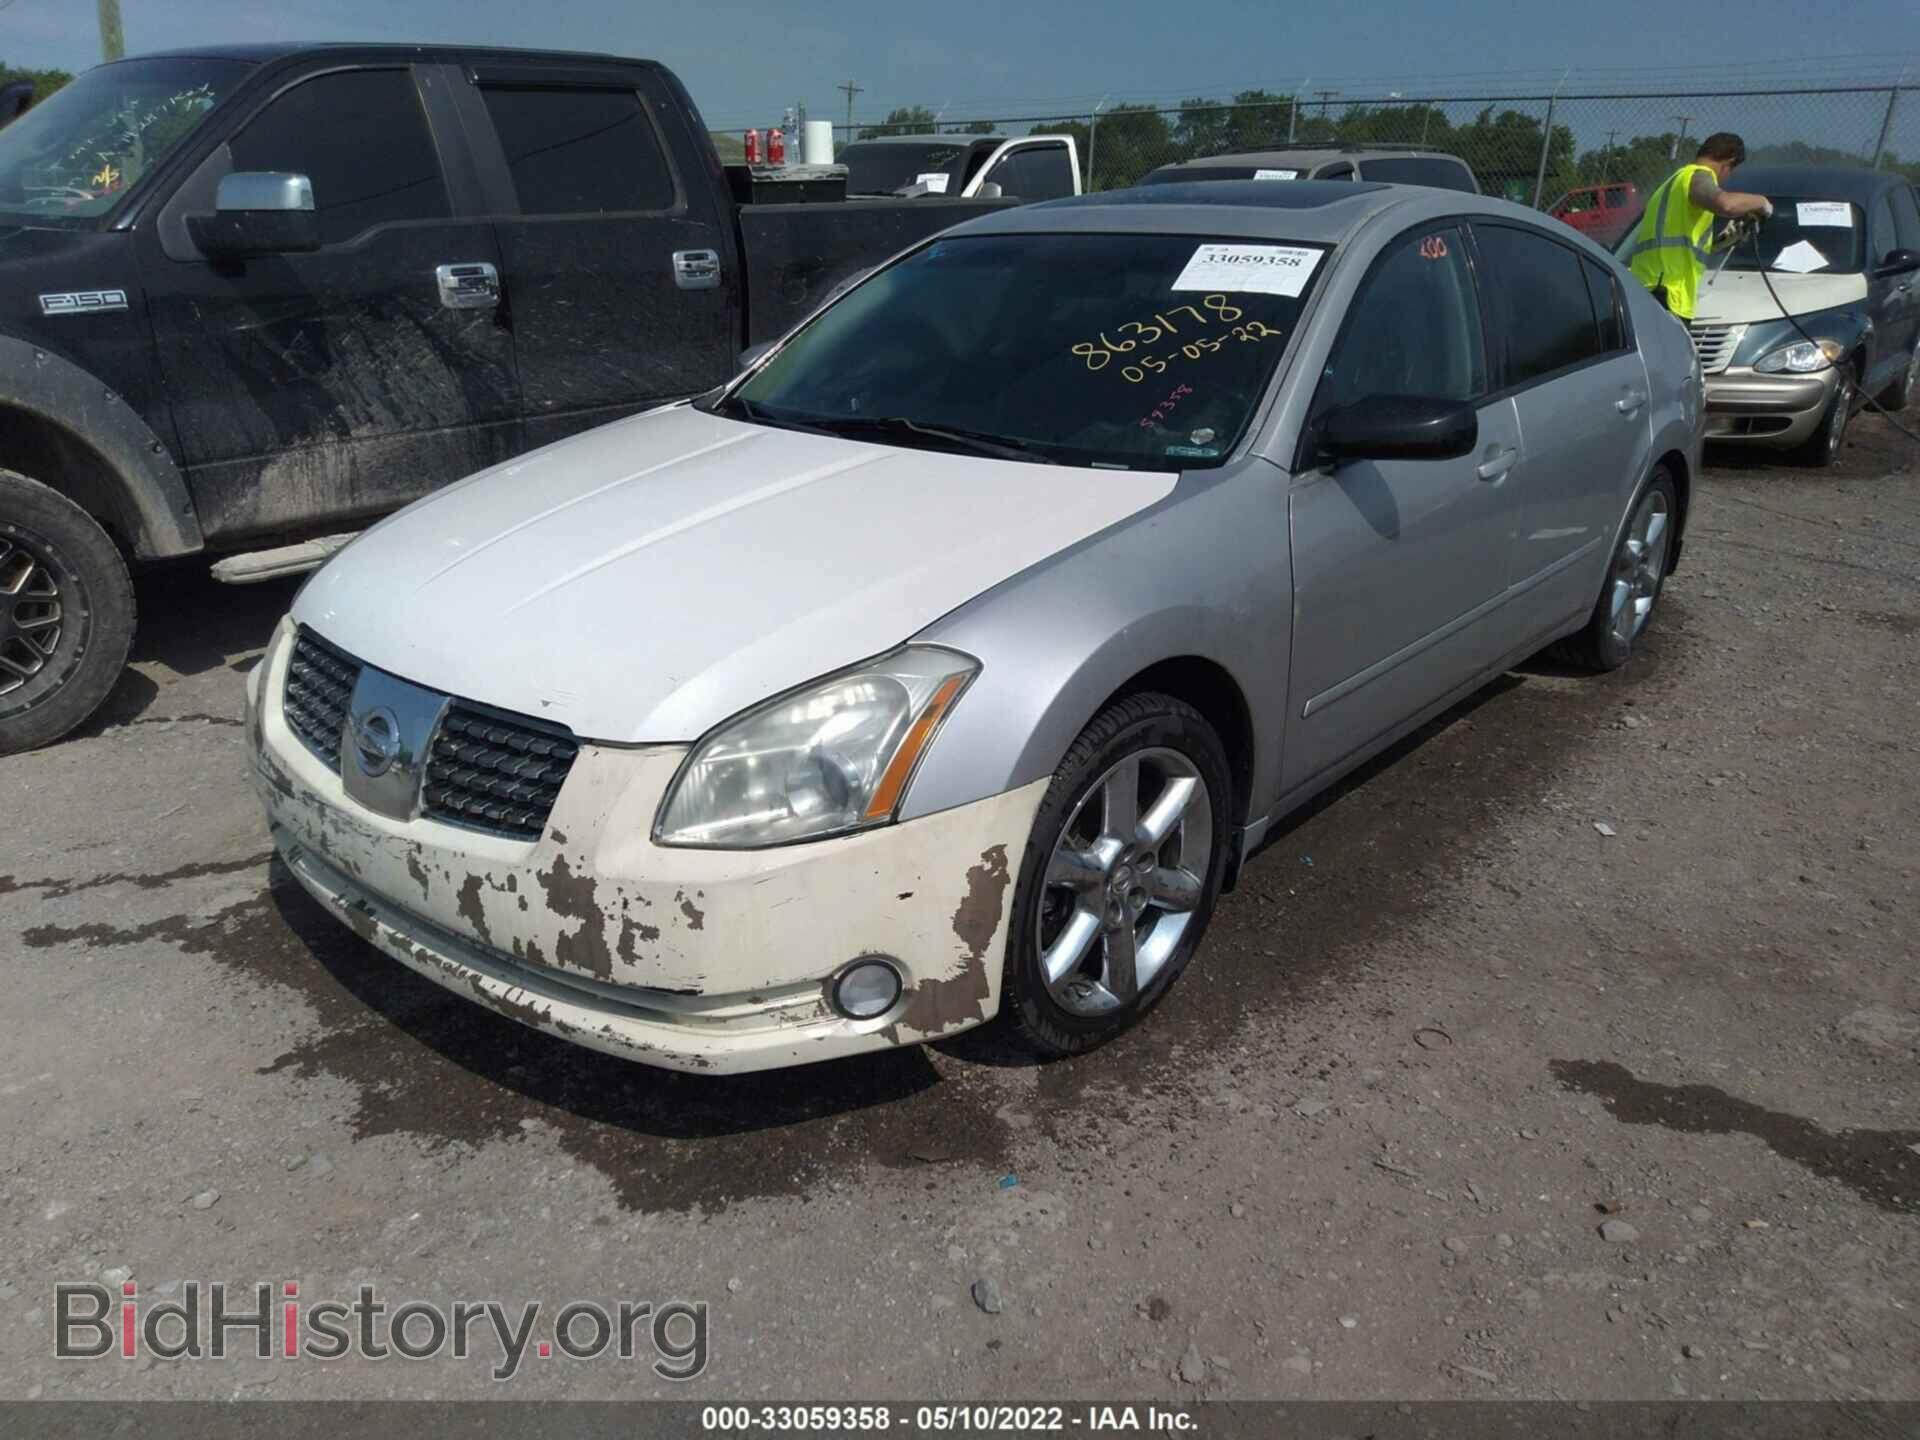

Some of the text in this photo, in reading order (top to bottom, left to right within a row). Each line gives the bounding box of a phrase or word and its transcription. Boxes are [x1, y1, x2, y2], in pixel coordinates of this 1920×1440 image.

[1201, 254, 1302, 267] 33059358
[1071, 294, 1242, 370] 863178
[1121, 321, 1281, 382] 05-05-22
